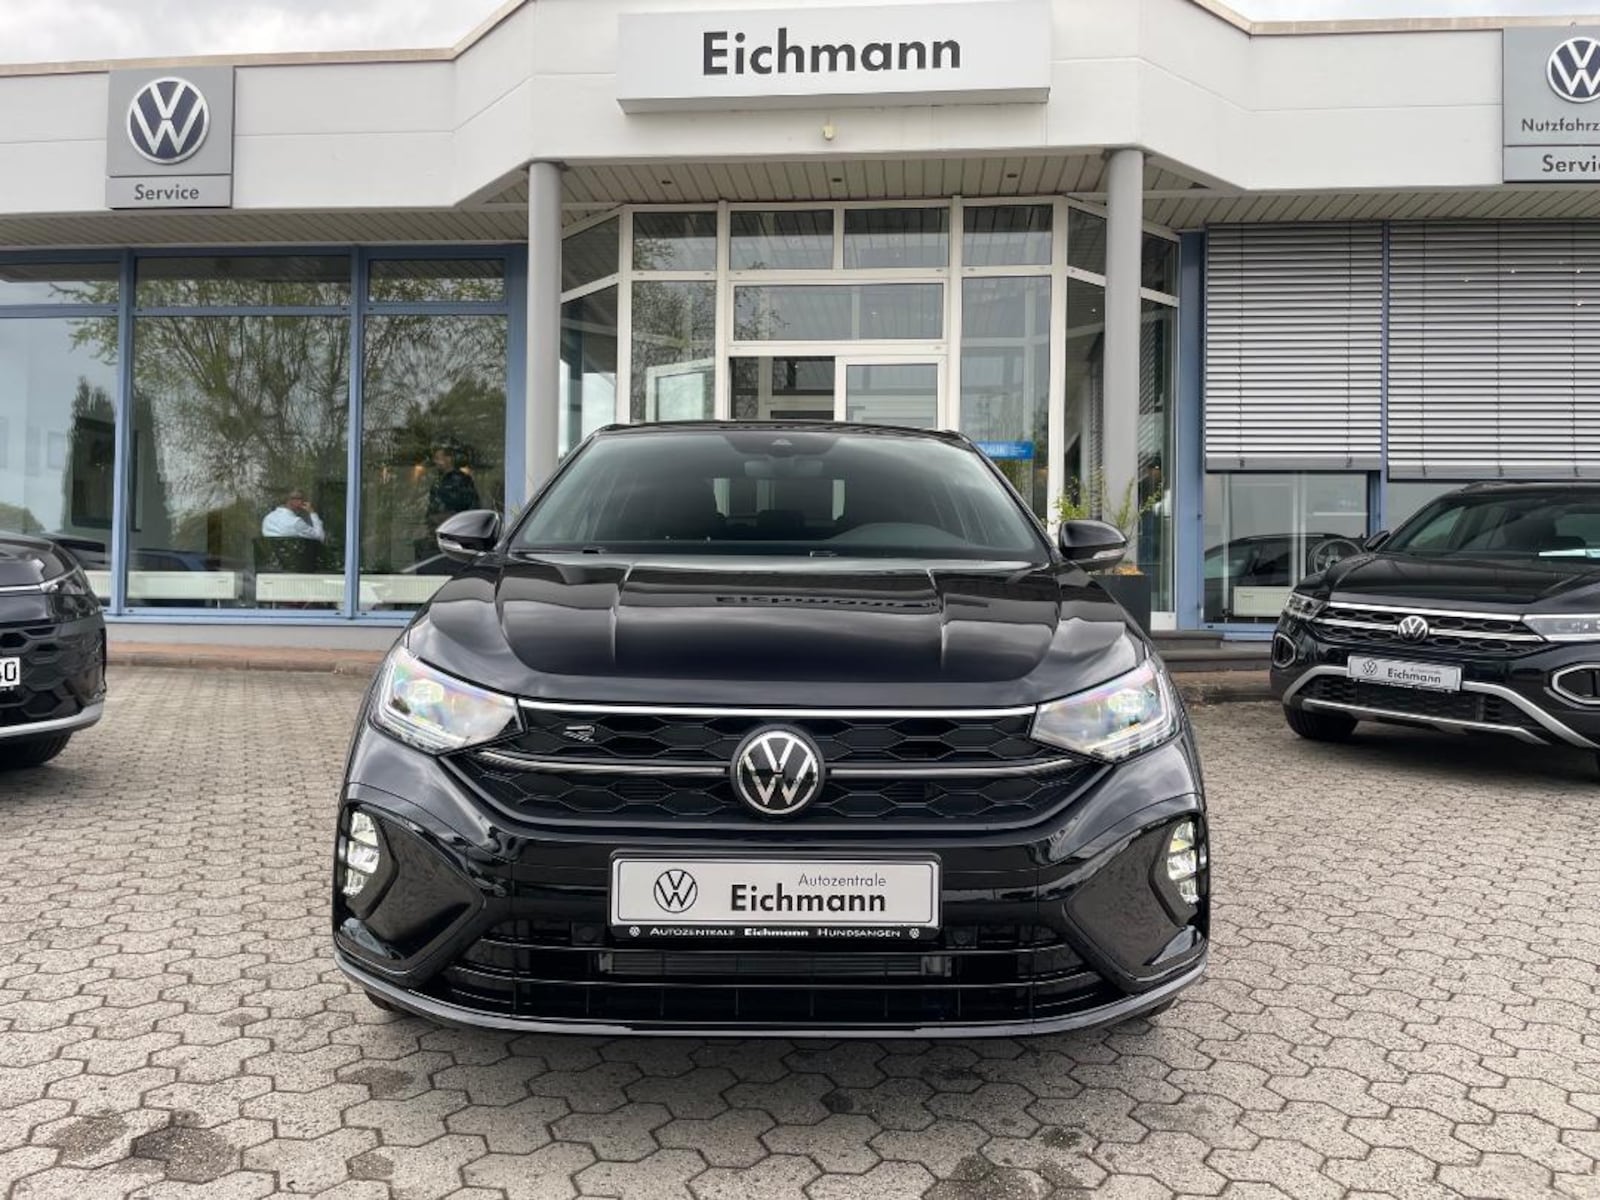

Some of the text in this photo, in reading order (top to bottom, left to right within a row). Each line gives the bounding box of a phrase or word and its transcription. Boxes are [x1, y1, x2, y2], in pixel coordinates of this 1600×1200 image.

[703, 27, 961, 76] Eichmann
[1541, 154, 1600, 173] Servi
[134, 183, 200, 201] Service
[1387, 667, 1441, 684] Eichmann
[798, 871, 887, 887] Autozentrale
[731, 883, 886, 912] Eichmann
[744, 927, 809, 937] Eichmann
[817, 927, 900, 938] HUNDSANGEN
